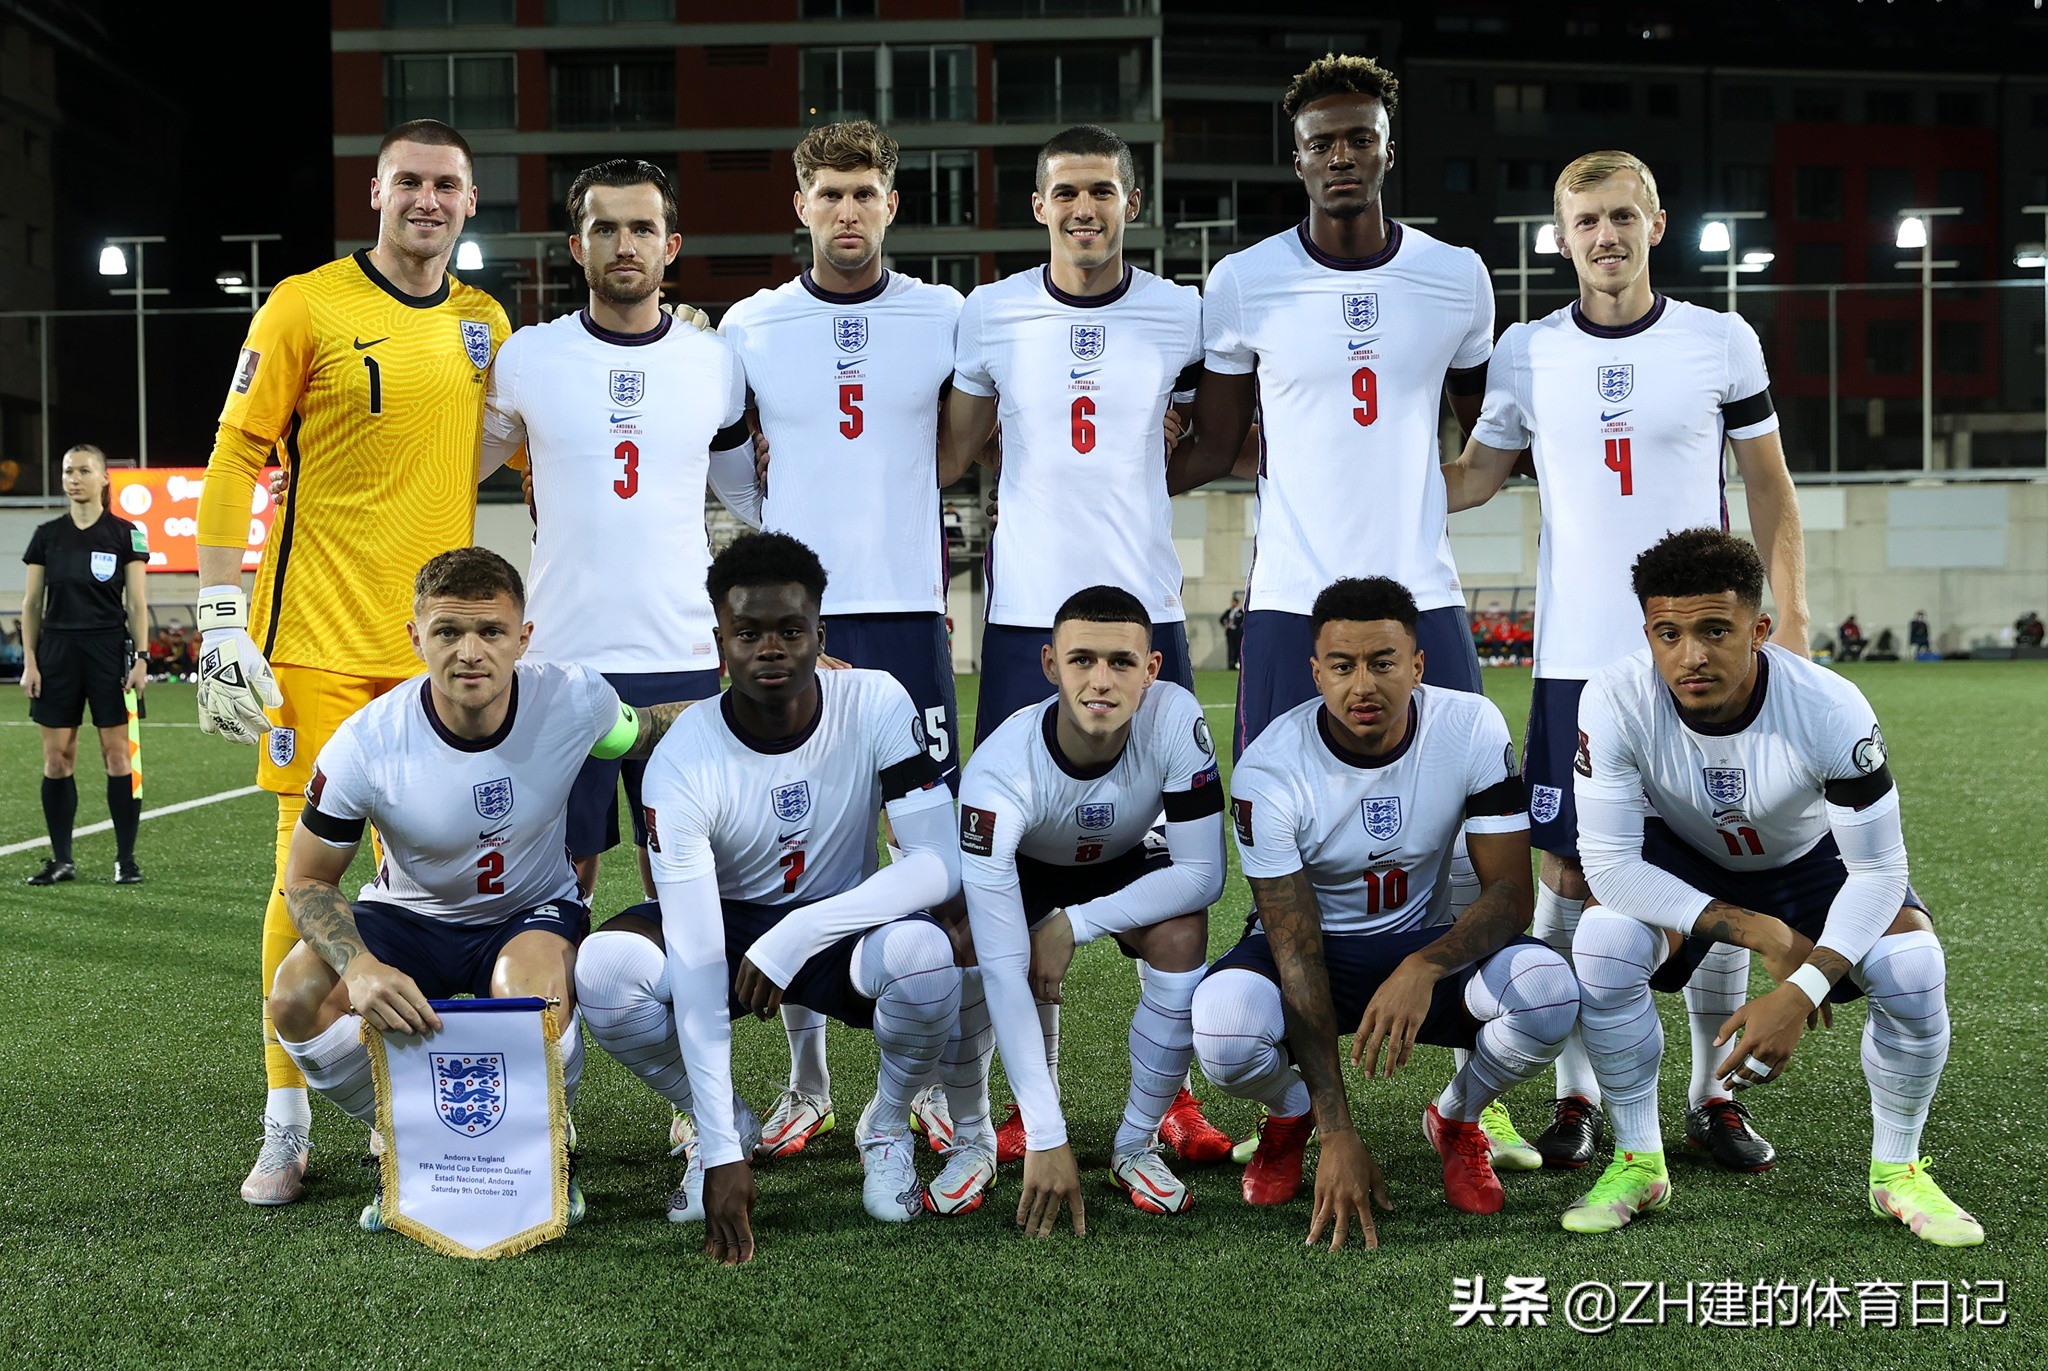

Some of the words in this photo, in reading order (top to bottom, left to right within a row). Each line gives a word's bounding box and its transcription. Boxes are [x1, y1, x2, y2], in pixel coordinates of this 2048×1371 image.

[364, 356, 381, 413] 1
[1352, 367, 1378, 427] 9
[839, 384, 863, 440] 5
[1071, 396, 1096, 454] 6
[614, 440, 639, 499] 3
[1604, 438, 1633, 496] 4
[925, 705, 949, 762] 5
[1716, 826, 1765, 856] 11
[477, 851, 504, 894] 2
[780, 851, 805, 893] 7
[1364, 868, 1408, 914] 10
[435, 1163, 455, 1171] World
[457, 1165, 469, 1174] Cup
[472, 1166, 502, 1176] European
[504, 1167, 531, 1176] Qualifier
[435, 1174, 455, 1182] Estadi
[456, 1175, 486, 1185] Nacional,
[488, 1177, 514, 1186] Andorra
[444, 1154, 471, 1162] Andorra
[478, 1155, 505, 1164] England
[431, 1185, 460, 1194] Saturday
[474, 1188, 500, 1196] October
[502, 1189, 517, 1197] 2021
